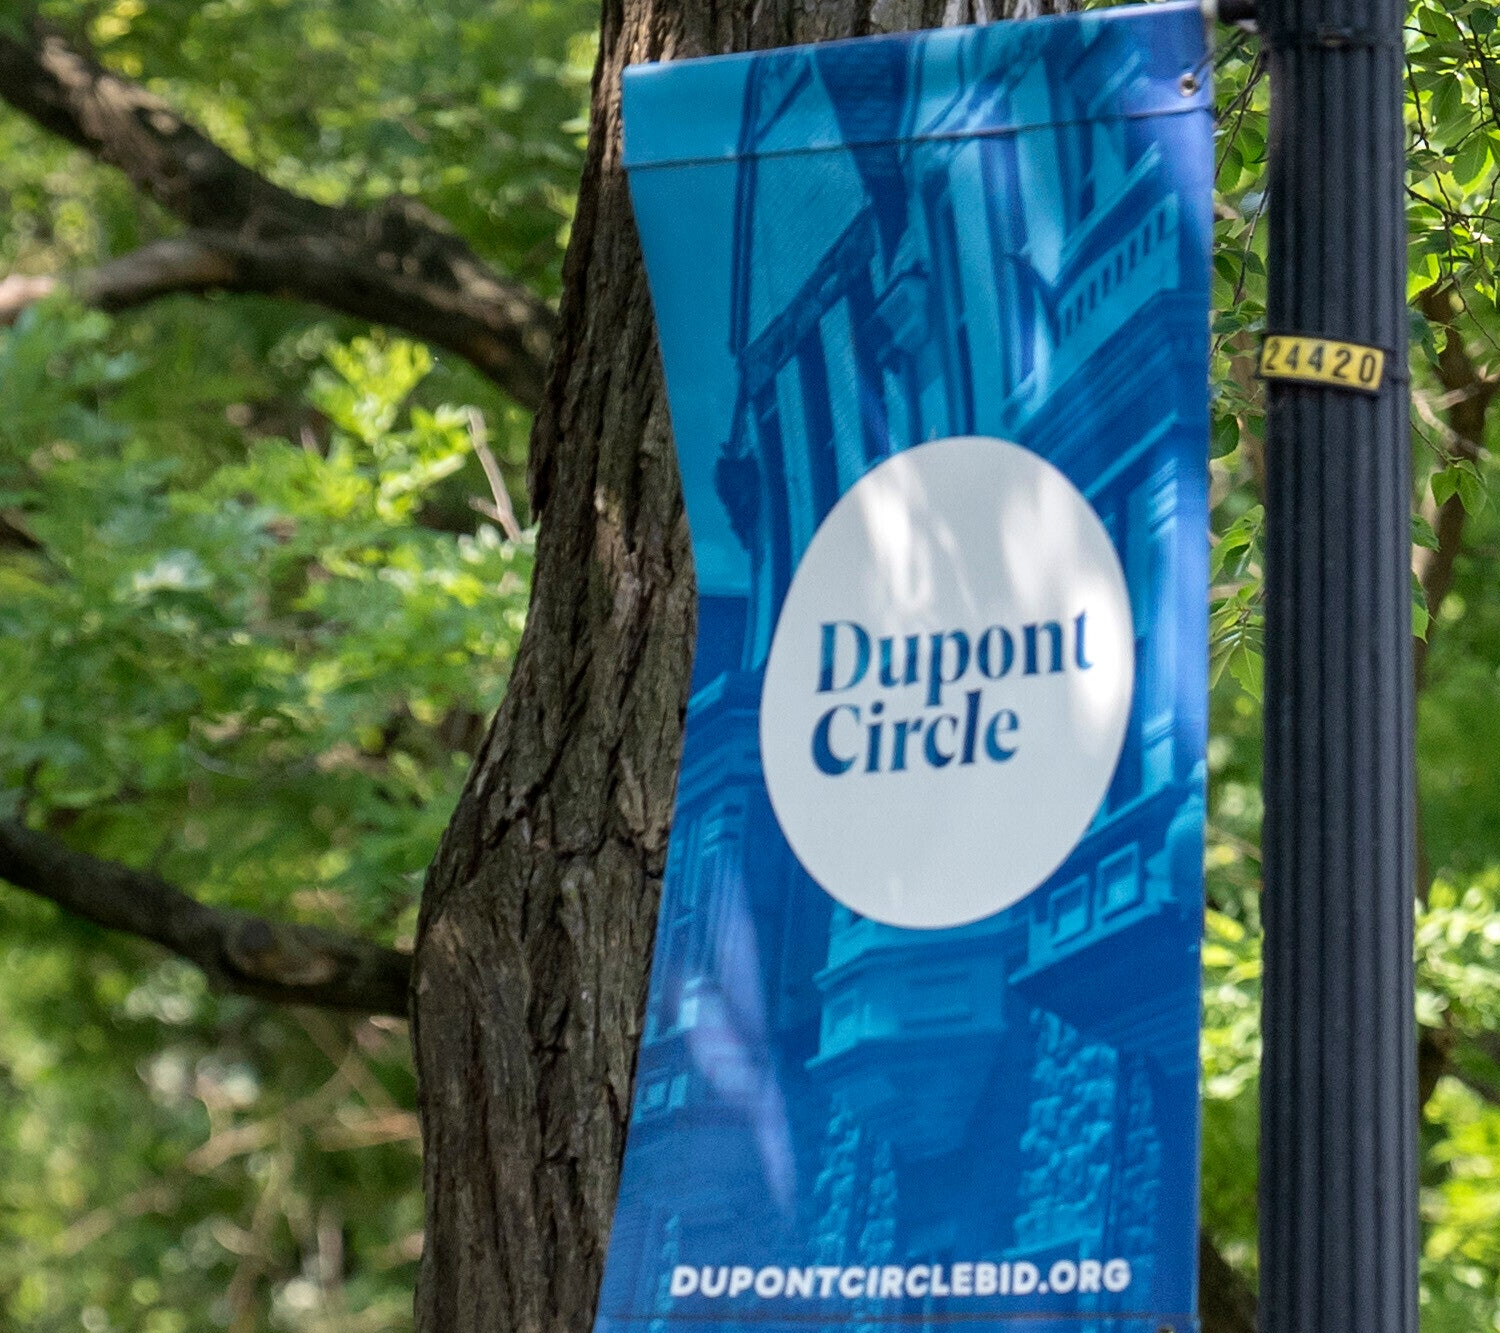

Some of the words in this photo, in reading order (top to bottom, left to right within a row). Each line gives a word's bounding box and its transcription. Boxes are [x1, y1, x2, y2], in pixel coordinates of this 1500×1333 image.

[1265, 339, 1376, 382] 24420
[816, 608, 1094, 707] Dupont
[810, 688, 1020, 776] Circle
[669, 1258, 1131, 1299] DUPONTCIRCLEBID.ORG
